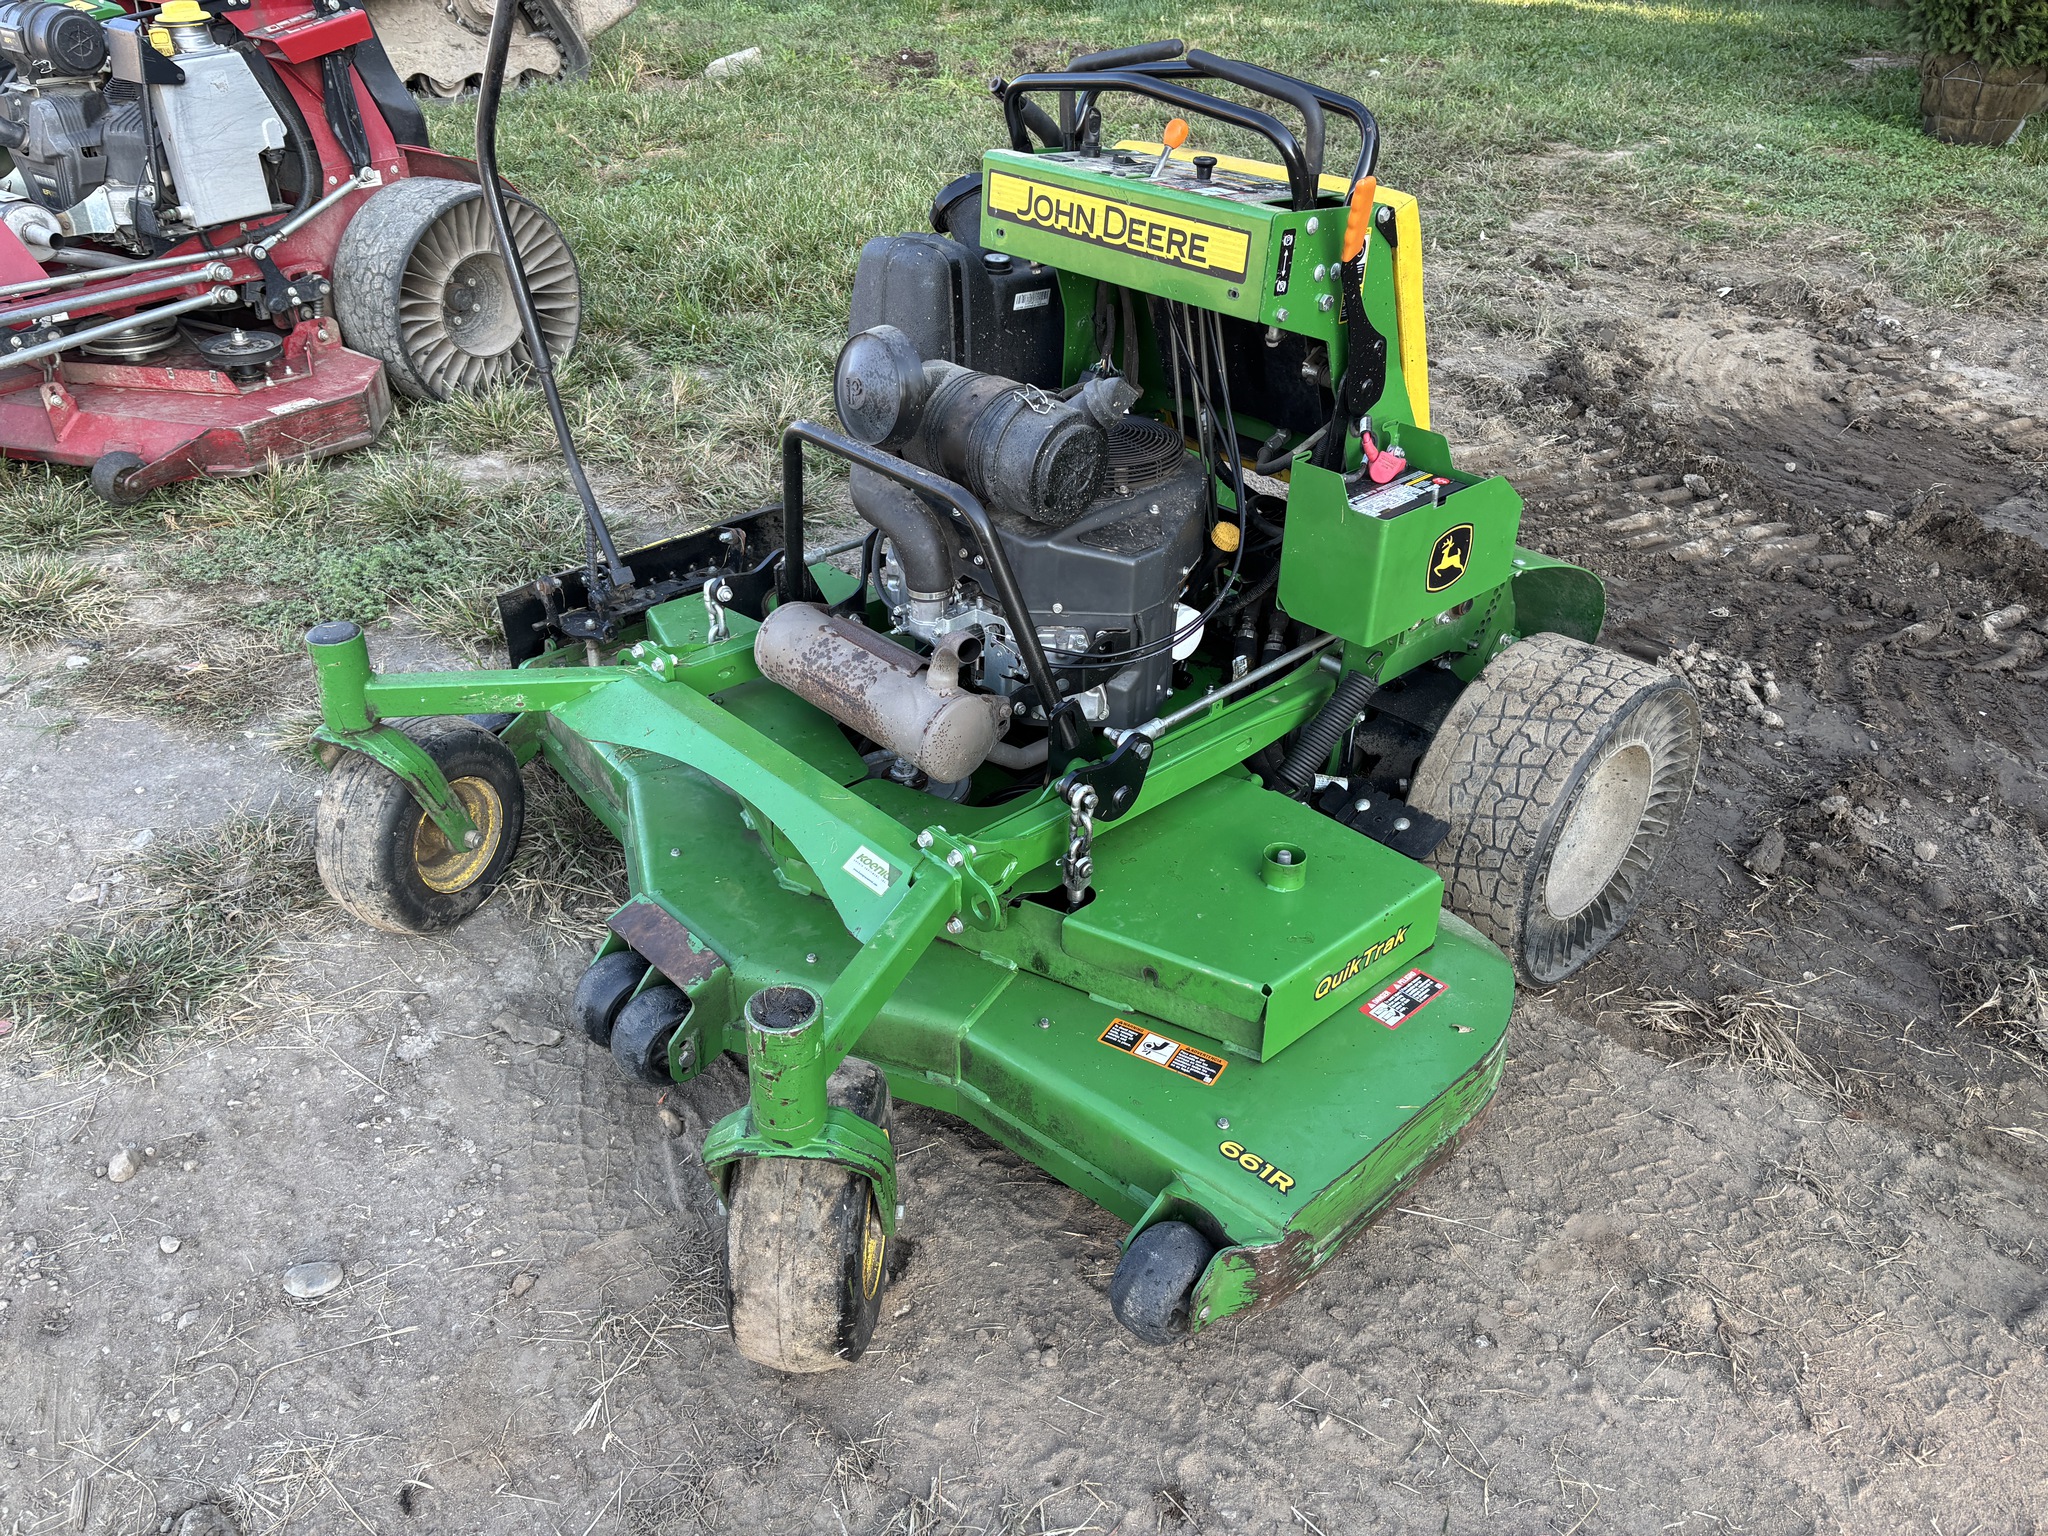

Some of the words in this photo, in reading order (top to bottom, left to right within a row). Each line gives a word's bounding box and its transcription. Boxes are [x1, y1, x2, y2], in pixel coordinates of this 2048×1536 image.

[1017, 186, 1096, 234] JOHN
[1103, 205, 1210, 264] DEERE
[1313, 925, 1409, 1001] QuikTrak
[1123, 1021, 1145, 1032] WARNING
[1191, 1049, 1222, 1063] ADVERTENCIA
[1219, 1140, 1296, 1195] 661R
